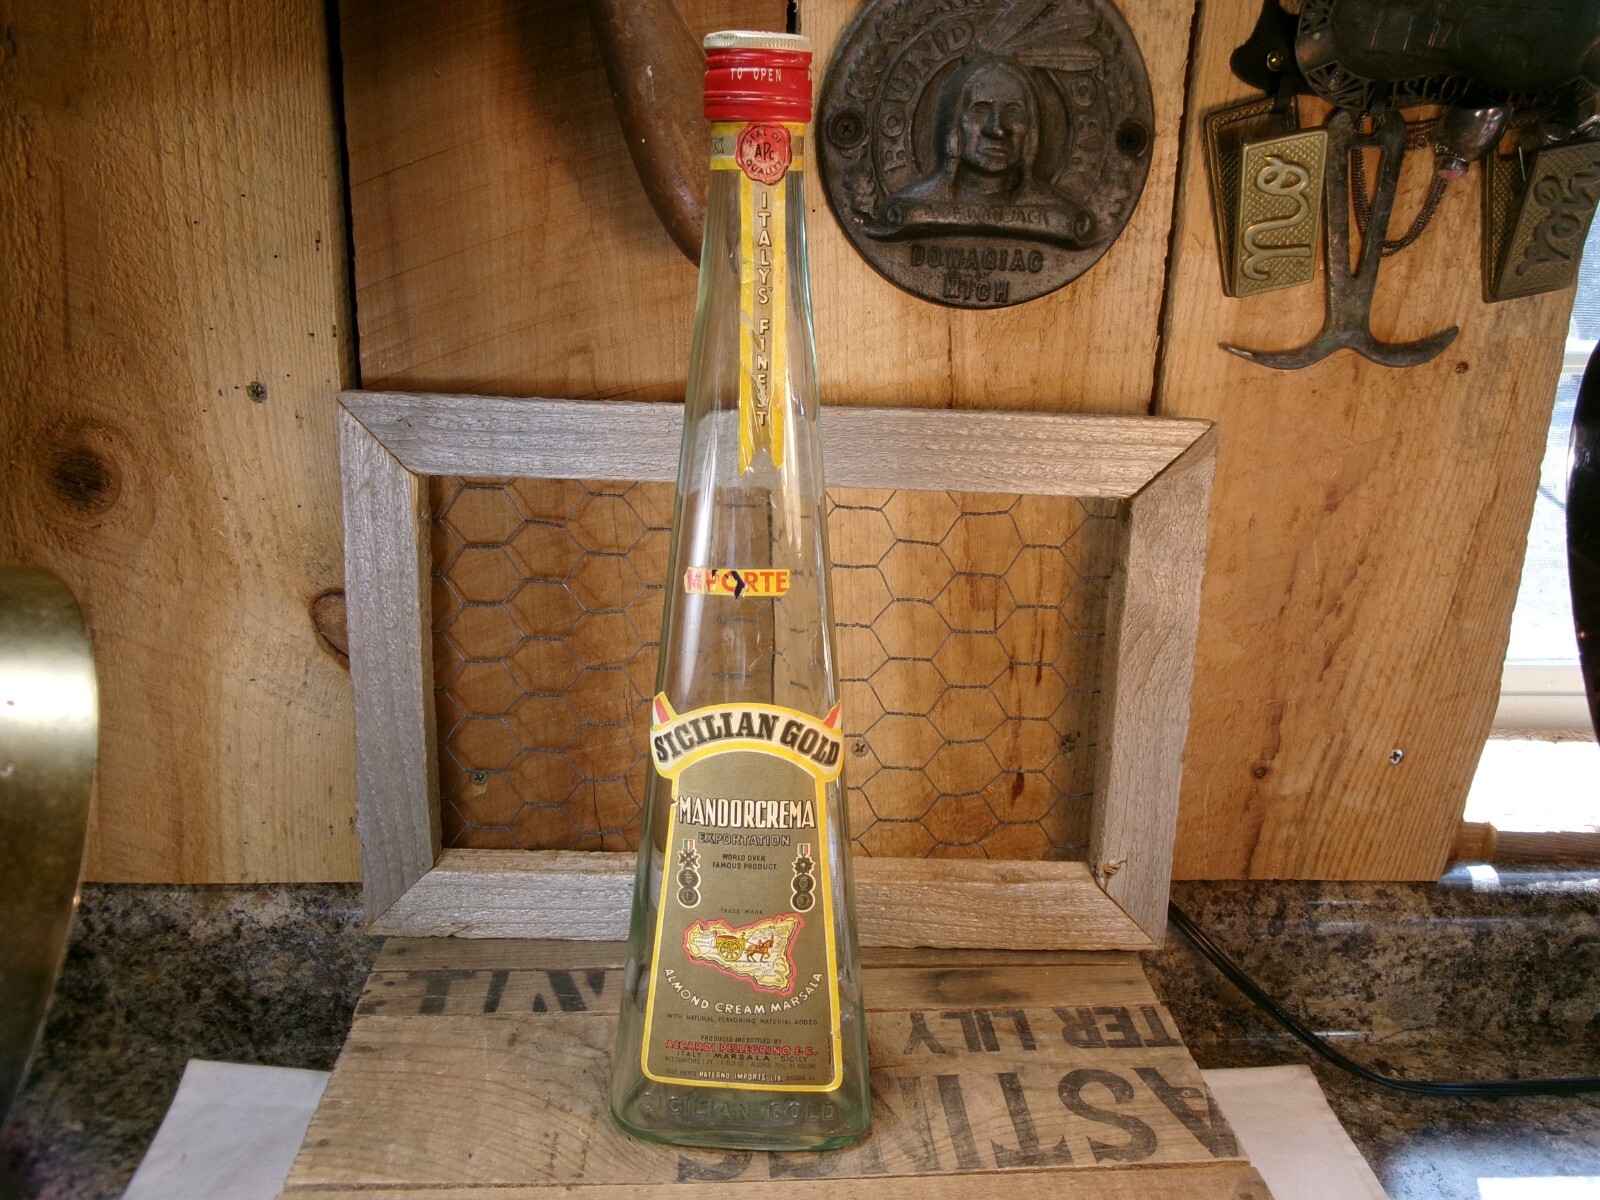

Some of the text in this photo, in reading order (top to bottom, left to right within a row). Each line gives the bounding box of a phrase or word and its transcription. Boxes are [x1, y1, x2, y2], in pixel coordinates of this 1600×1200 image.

[730, 67, 782, 82] TO OPEN
[745, 128, 784, 147] SEAL OF
[745, 159, 782, 175] QUALITY
[653, 711, 841, 768] SICILIAN GOLD
[678, 796, 817, 830] MANDORCREMA
[698, 832, 791, 847] EXPORTATION
[722, 853, 766, 862] WORLD OVER
[712, 861, 777, 871] FAMOUS PRODUCT
[720, 907, 740, 915] TRADE
[664, 967, 824, 1015] ALMOND CREAM MARSALA
[666, 1012, 818, 1026] WITH NATURAL FLAVORING MATERIAL ADDED
[700, 1034, 733, 1043] PRODUCED
[746, 1036, 771, 1044] BOTTLED
[666, 1039, 716, 1052] ACCARDI
[720, 1042, 792, 1056] PELLEGRINO
[677, 1050, 809, 1063] ITALY MARSALA SICILY
[699, 1070, 730, 1080] PATERNO
[734, 1072, 766, 1082] IMPORTS
